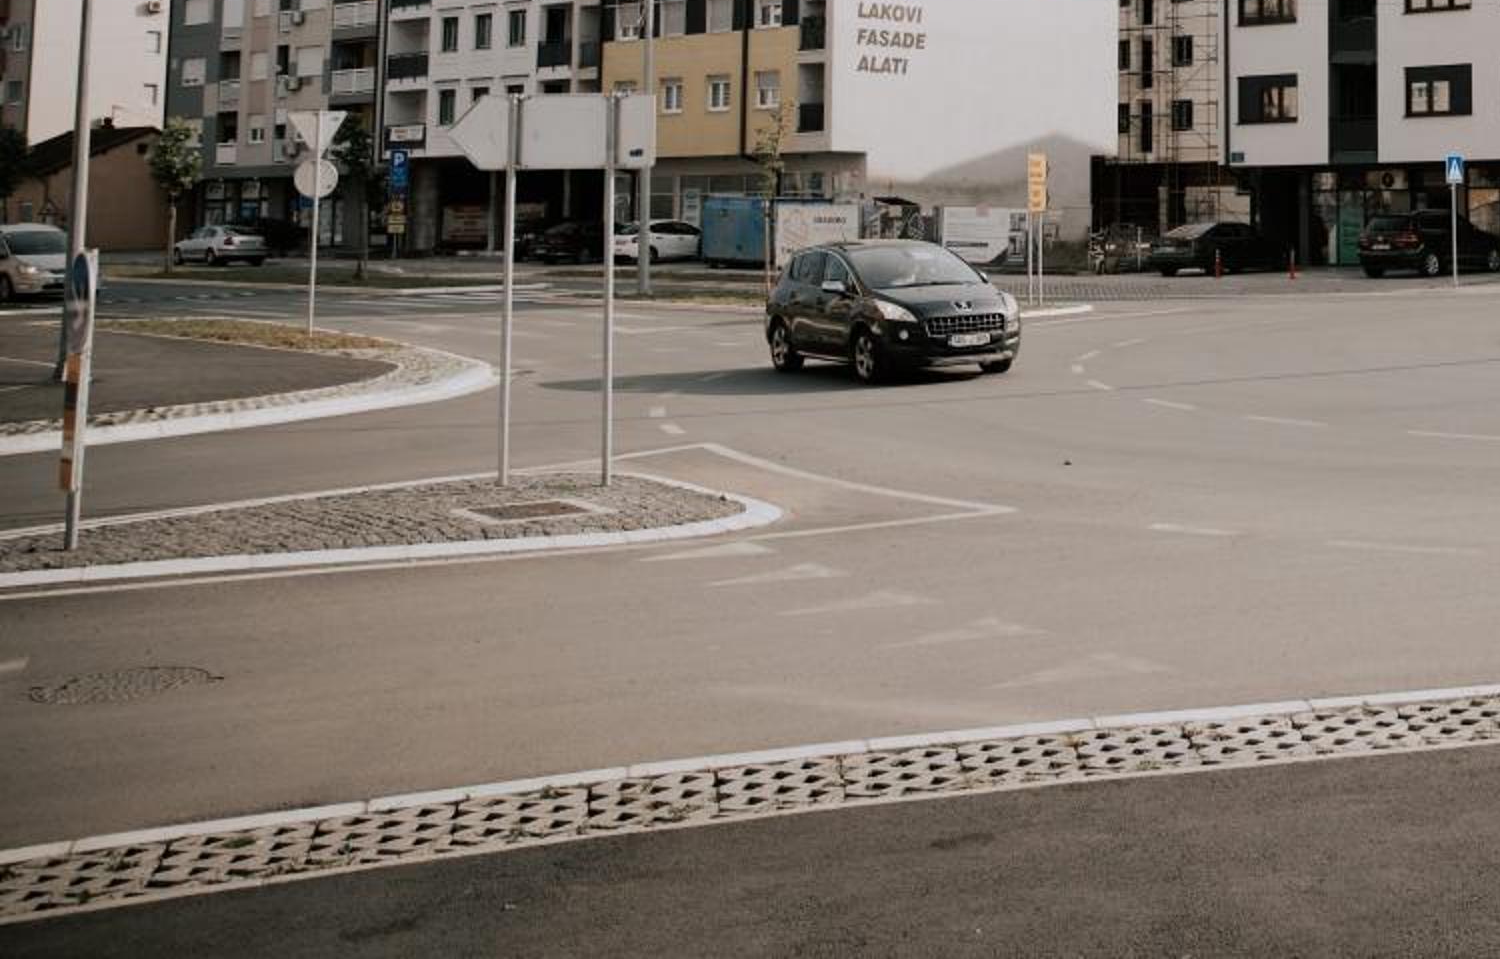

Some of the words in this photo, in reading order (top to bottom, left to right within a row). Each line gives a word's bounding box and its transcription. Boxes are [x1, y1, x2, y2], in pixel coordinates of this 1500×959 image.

[857, 2, 922, 23] LAKOVI
[857, 28, 926, 49] FASADE
[857, 54, 909, 75] ALATI
[393, 152, 405, 166] P
